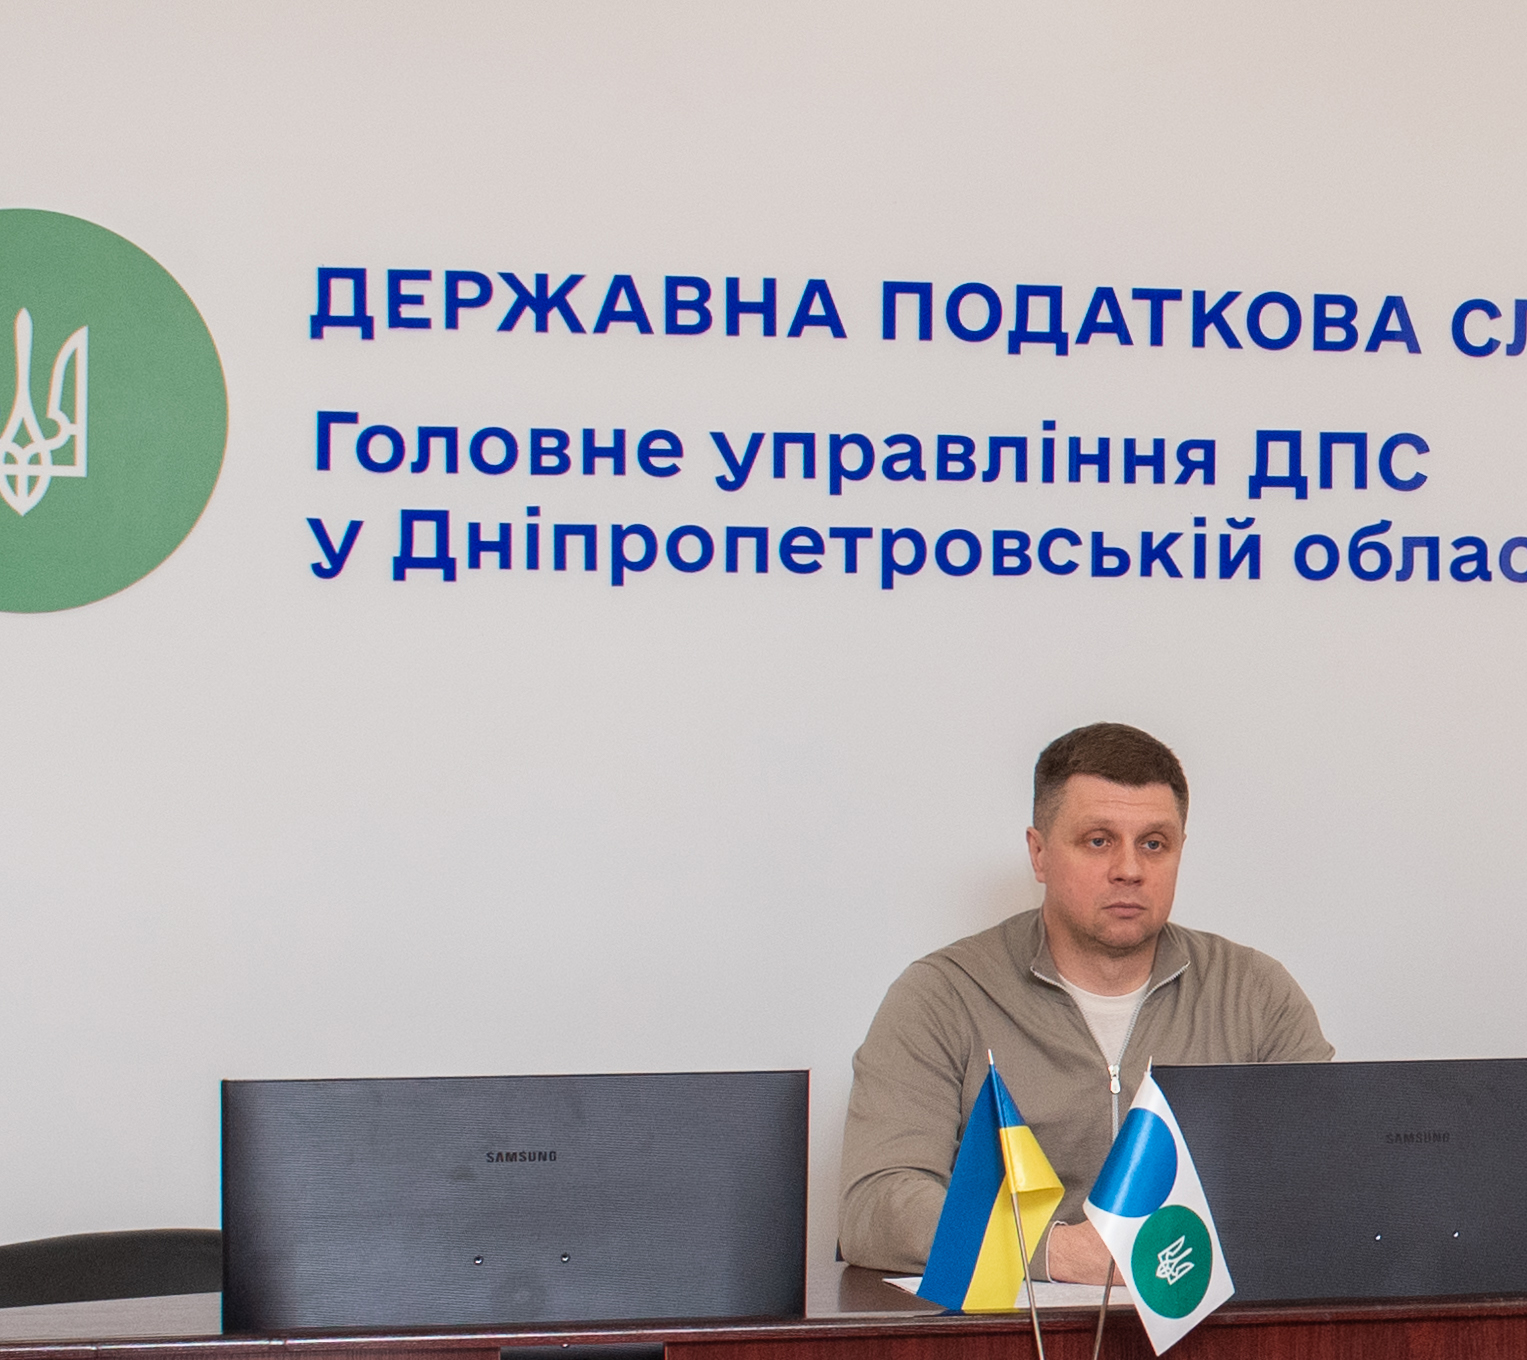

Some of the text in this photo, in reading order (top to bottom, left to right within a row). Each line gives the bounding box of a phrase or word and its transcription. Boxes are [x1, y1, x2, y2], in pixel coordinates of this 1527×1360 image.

[307, 265, 846, 341] ДЕРЖАВНА
[880, 279, 1421, 357] ПОДАТКОВА
[314, 409, 1430, 501] Головне управління ДПС
[304, 516, 363, 580] у
[390, 504, 1261, 591] Дніпропетровській
[486, 1151, 557, 1163] SAMSUNG
[1386, 1131, 1450, 1144] SAMSUNG
